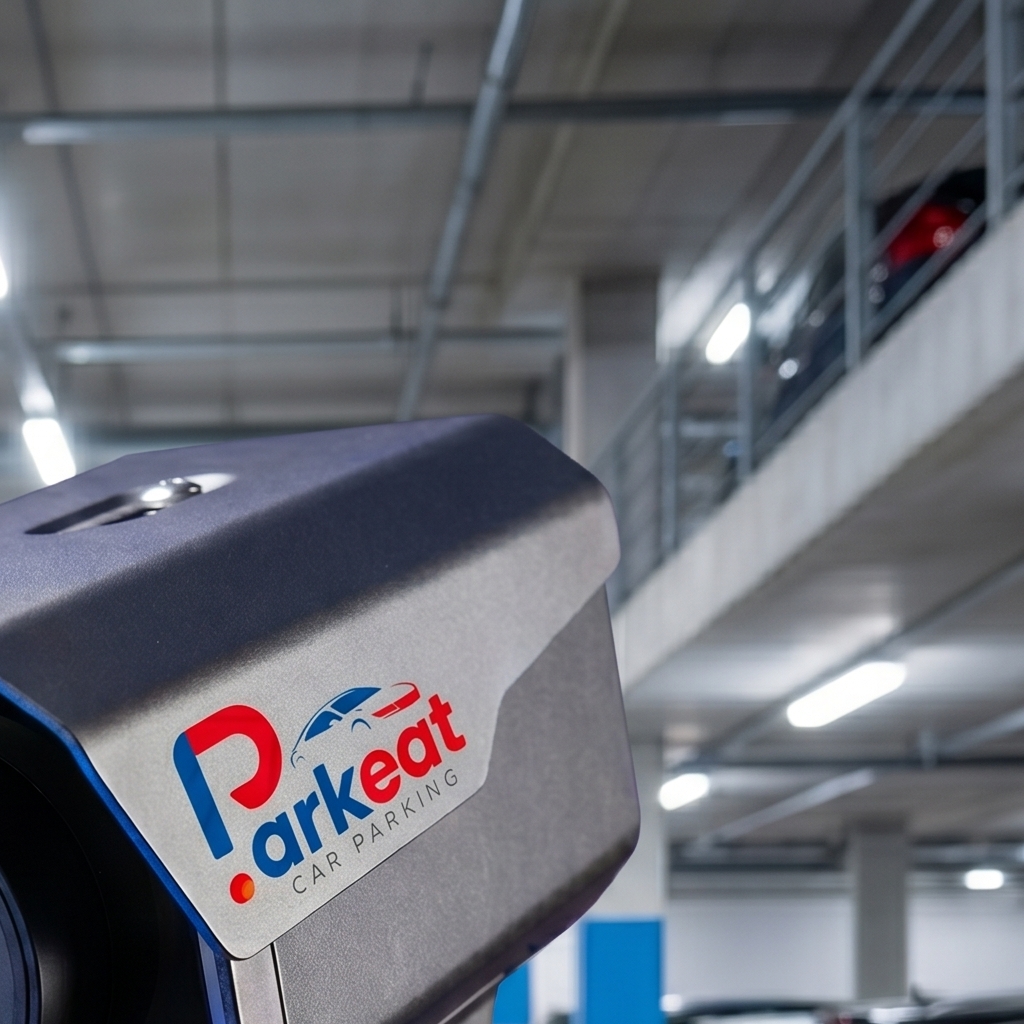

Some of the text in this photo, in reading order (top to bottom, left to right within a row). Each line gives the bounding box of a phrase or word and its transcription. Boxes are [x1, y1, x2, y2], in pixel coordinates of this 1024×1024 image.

[173, 693, 467, 881] Parkeat
[291, 767, 459, 895] CAR PARKING
